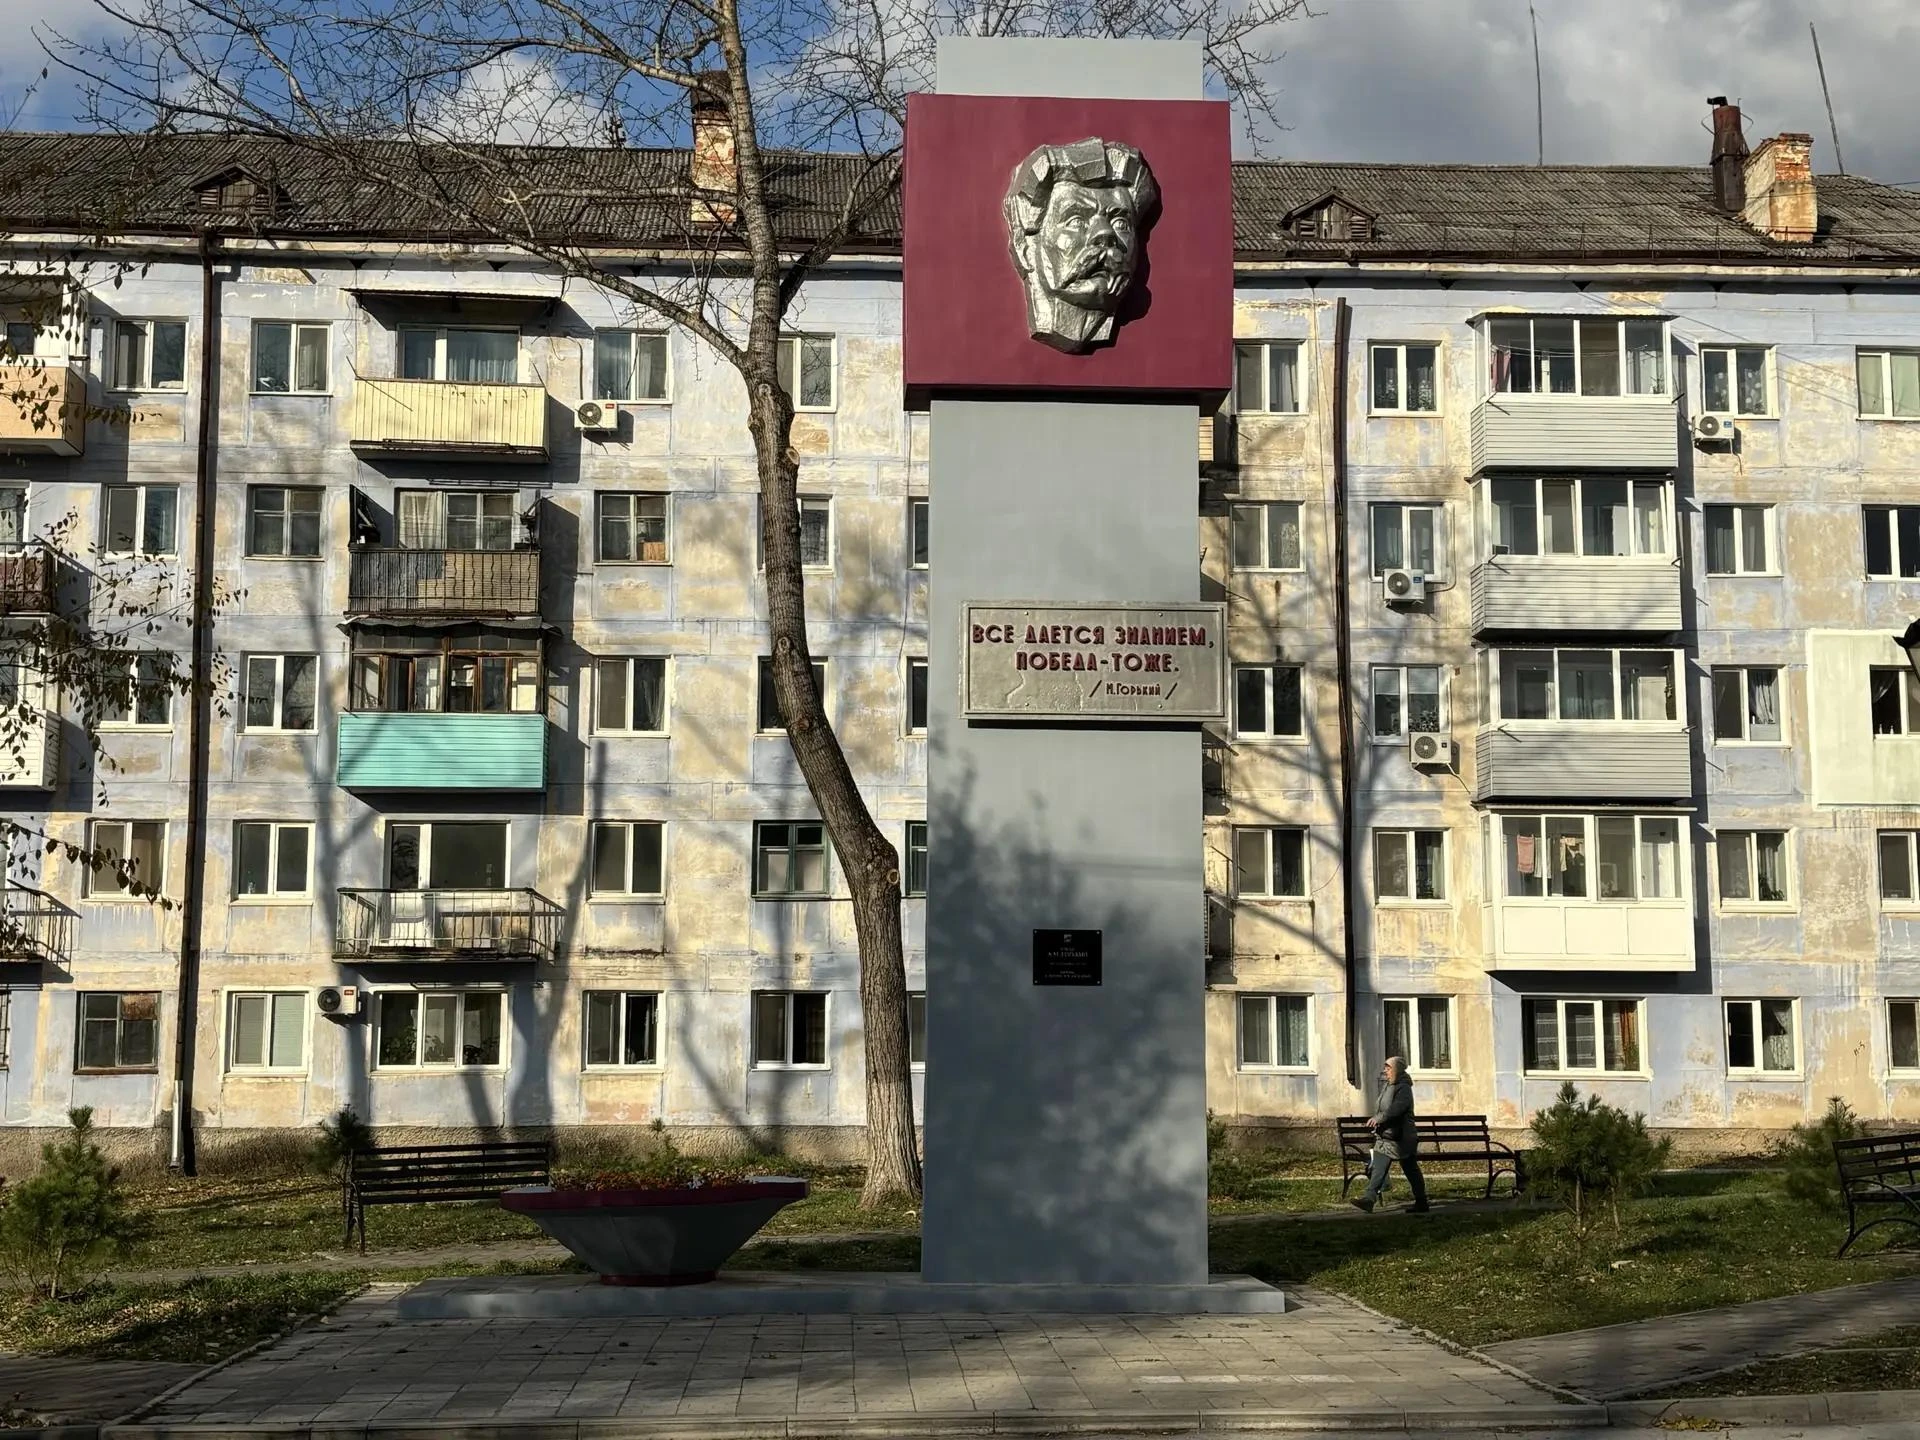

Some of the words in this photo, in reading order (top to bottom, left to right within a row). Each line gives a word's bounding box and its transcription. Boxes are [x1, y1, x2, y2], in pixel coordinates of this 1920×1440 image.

[972, 624, 1014, 643] ВСЕ
[1025, 625, 1105, 645] ДАЕТСЯ
[1115, 626, 1214, 648] ЗНАНИЕМ,
